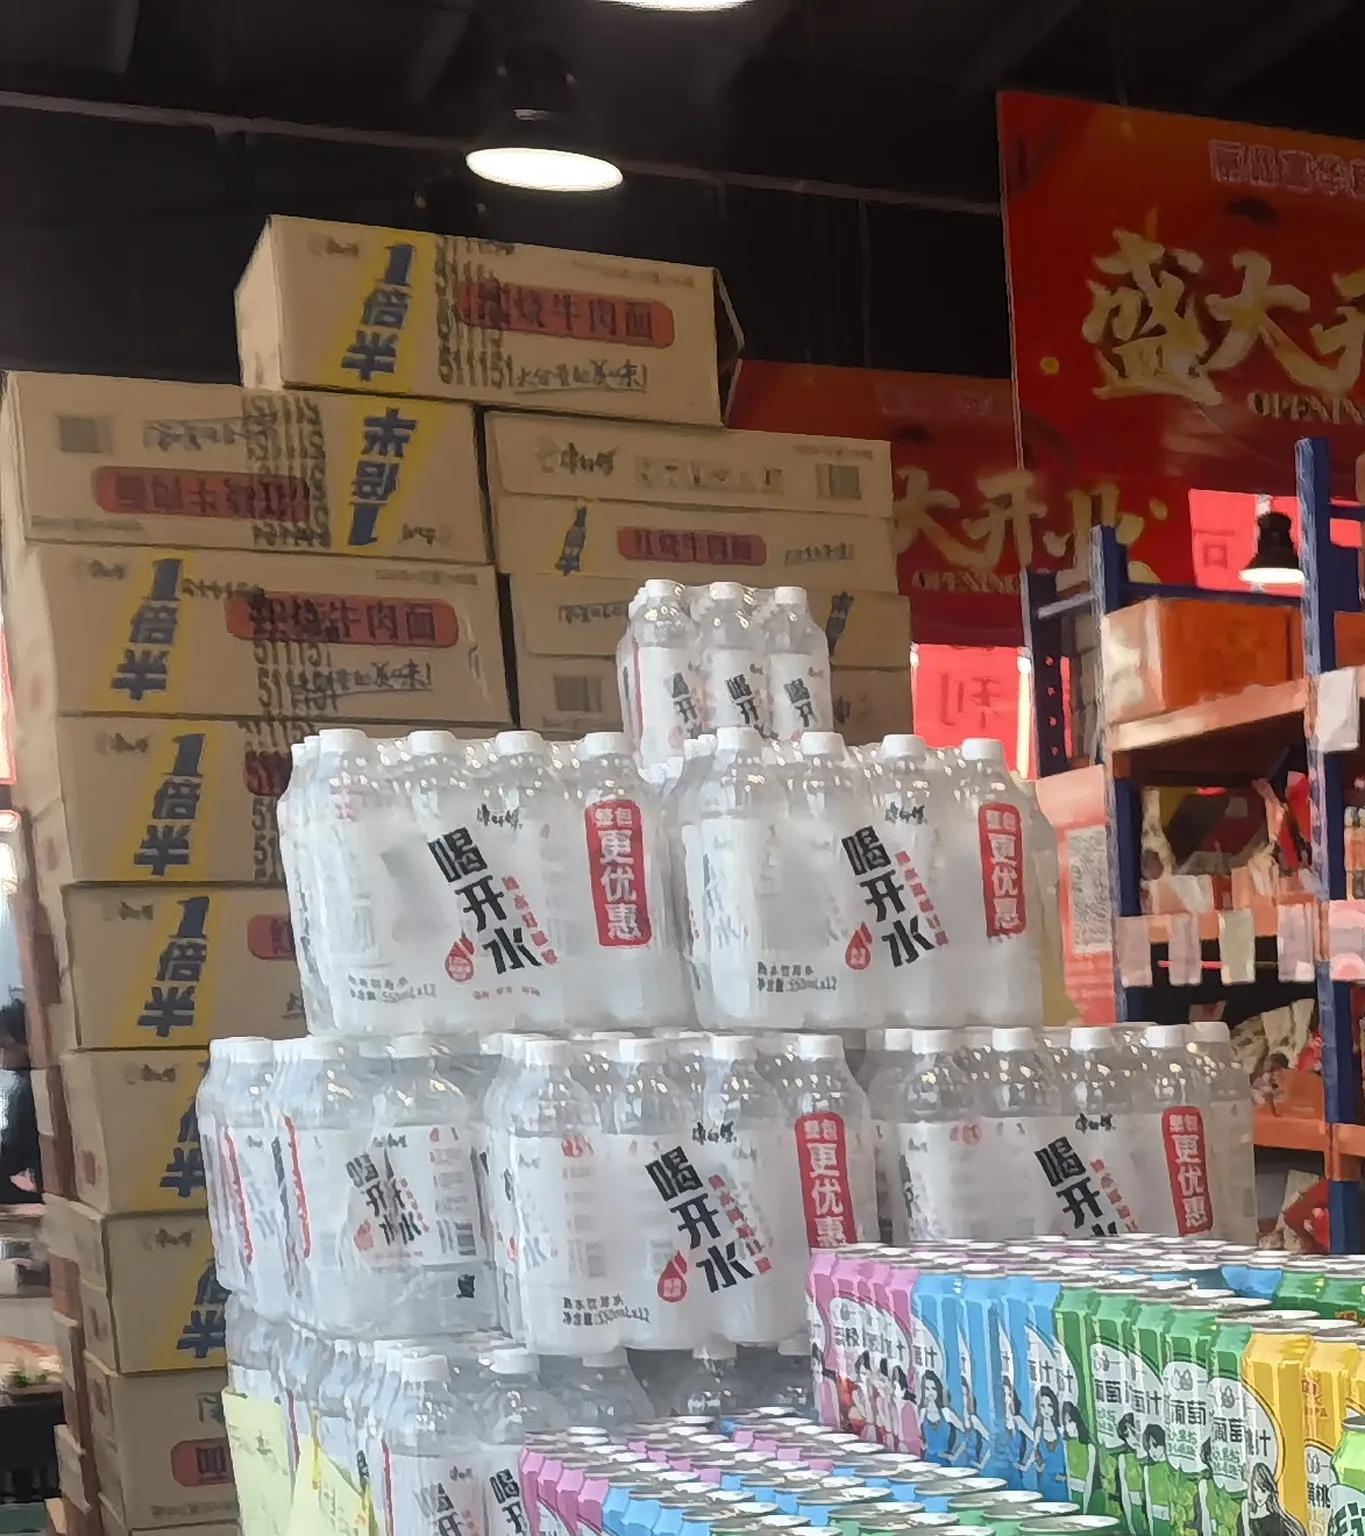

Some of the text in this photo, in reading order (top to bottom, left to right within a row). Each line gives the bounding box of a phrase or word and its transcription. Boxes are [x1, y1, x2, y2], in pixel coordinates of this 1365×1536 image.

[341, 243, 415, 382] 1倍半
[894, 466, 1145, 595] 大开业
[110, 558, 184, 701] 1倍半
[138, 733, 207, 877] 1倍半
[427, 827, 543, 975] 喝开水
[597, 828, 643, 942] 更优惠
[841, 825, 935, 967] 喝开水
[988, 832, 1020, 932] 更优惠
[136, 896, 210, 1038] 1倍半
[645, 1146, 755, 1294] 喝开水
[808, 1142, 850, 1247] 更优惠
[1172, 1136, 1212, 1231] 更优惠
